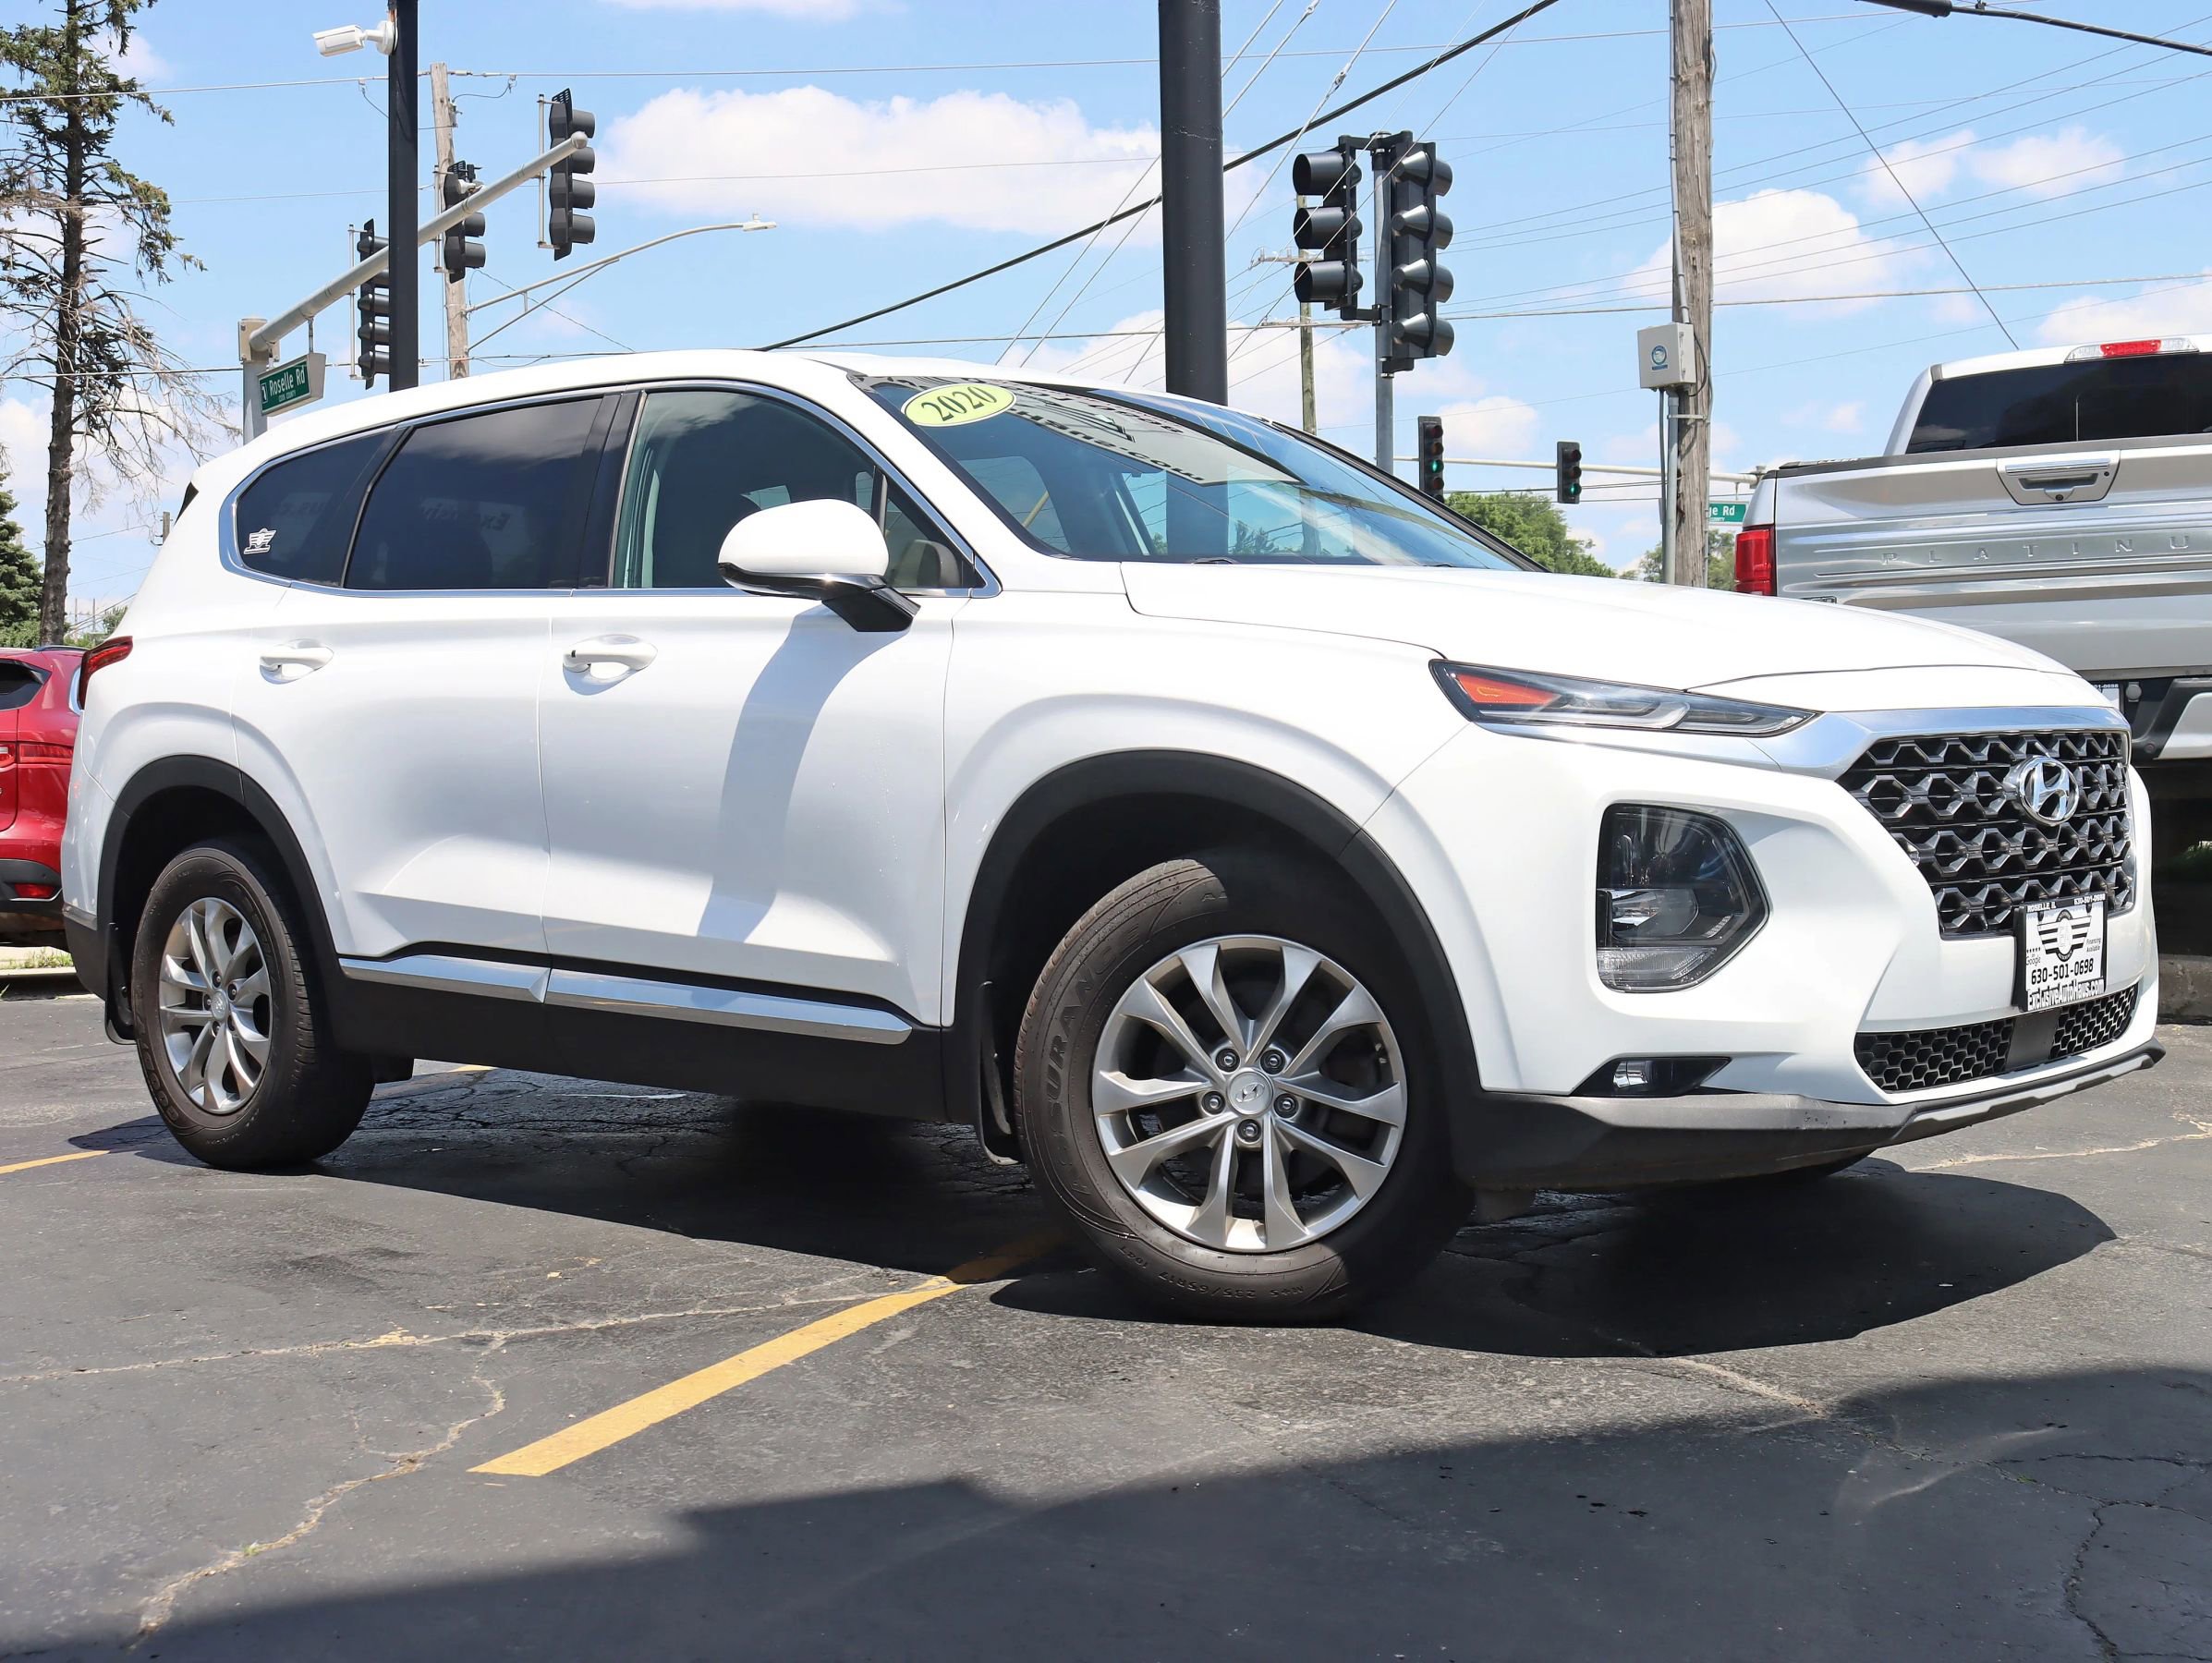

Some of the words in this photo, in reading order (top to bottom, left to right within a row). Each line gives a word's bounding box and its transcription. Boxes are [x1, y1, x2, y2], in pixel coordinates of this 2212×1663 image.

[269, 371, 294, 396] Roselle
[296, 365, 306, 385] Rd
[921, 386, 997, 421] 2020
[1722, 505, 1735, 516] Rd
[1882, 535, 2190, 565] PLATINU
[2031, 957, 2094, 985] 630-501-0698
[2027, 979, 2105, 1012] ExclusiveAutoHaus.com
